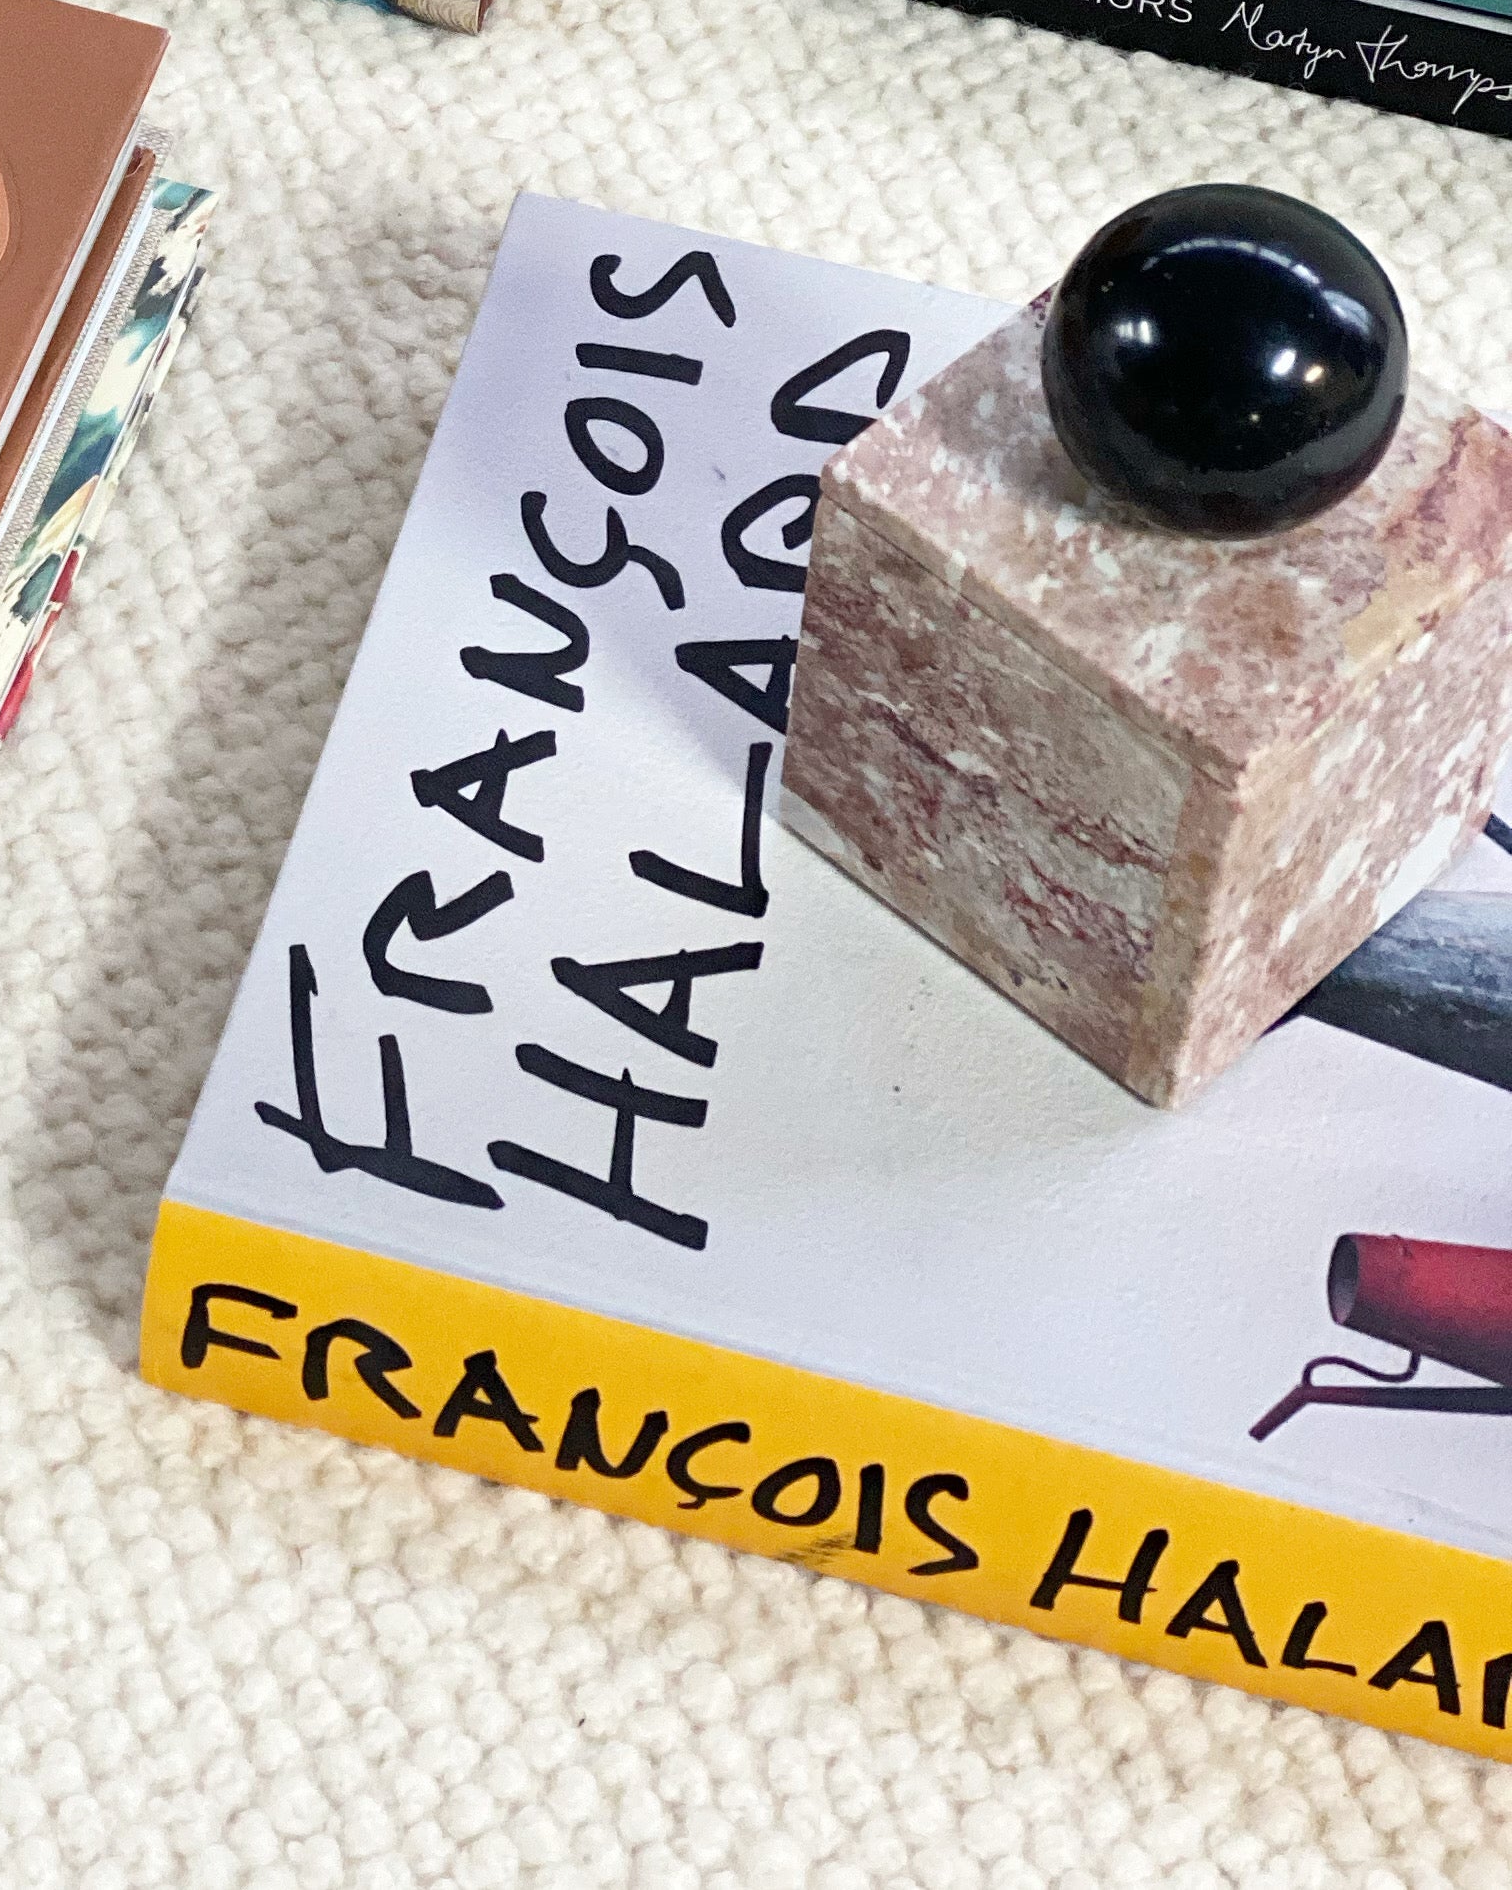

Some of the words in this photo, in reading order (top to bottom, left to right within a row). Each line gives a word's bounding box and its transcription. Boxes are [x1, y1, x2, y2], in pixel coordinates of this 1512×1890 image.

[1220, 1, 1346, 79] Martyn
[254, 249, 738, 1210] FRANÇOIS
[179, 1283, 980, 1577] FRANÇOIS
